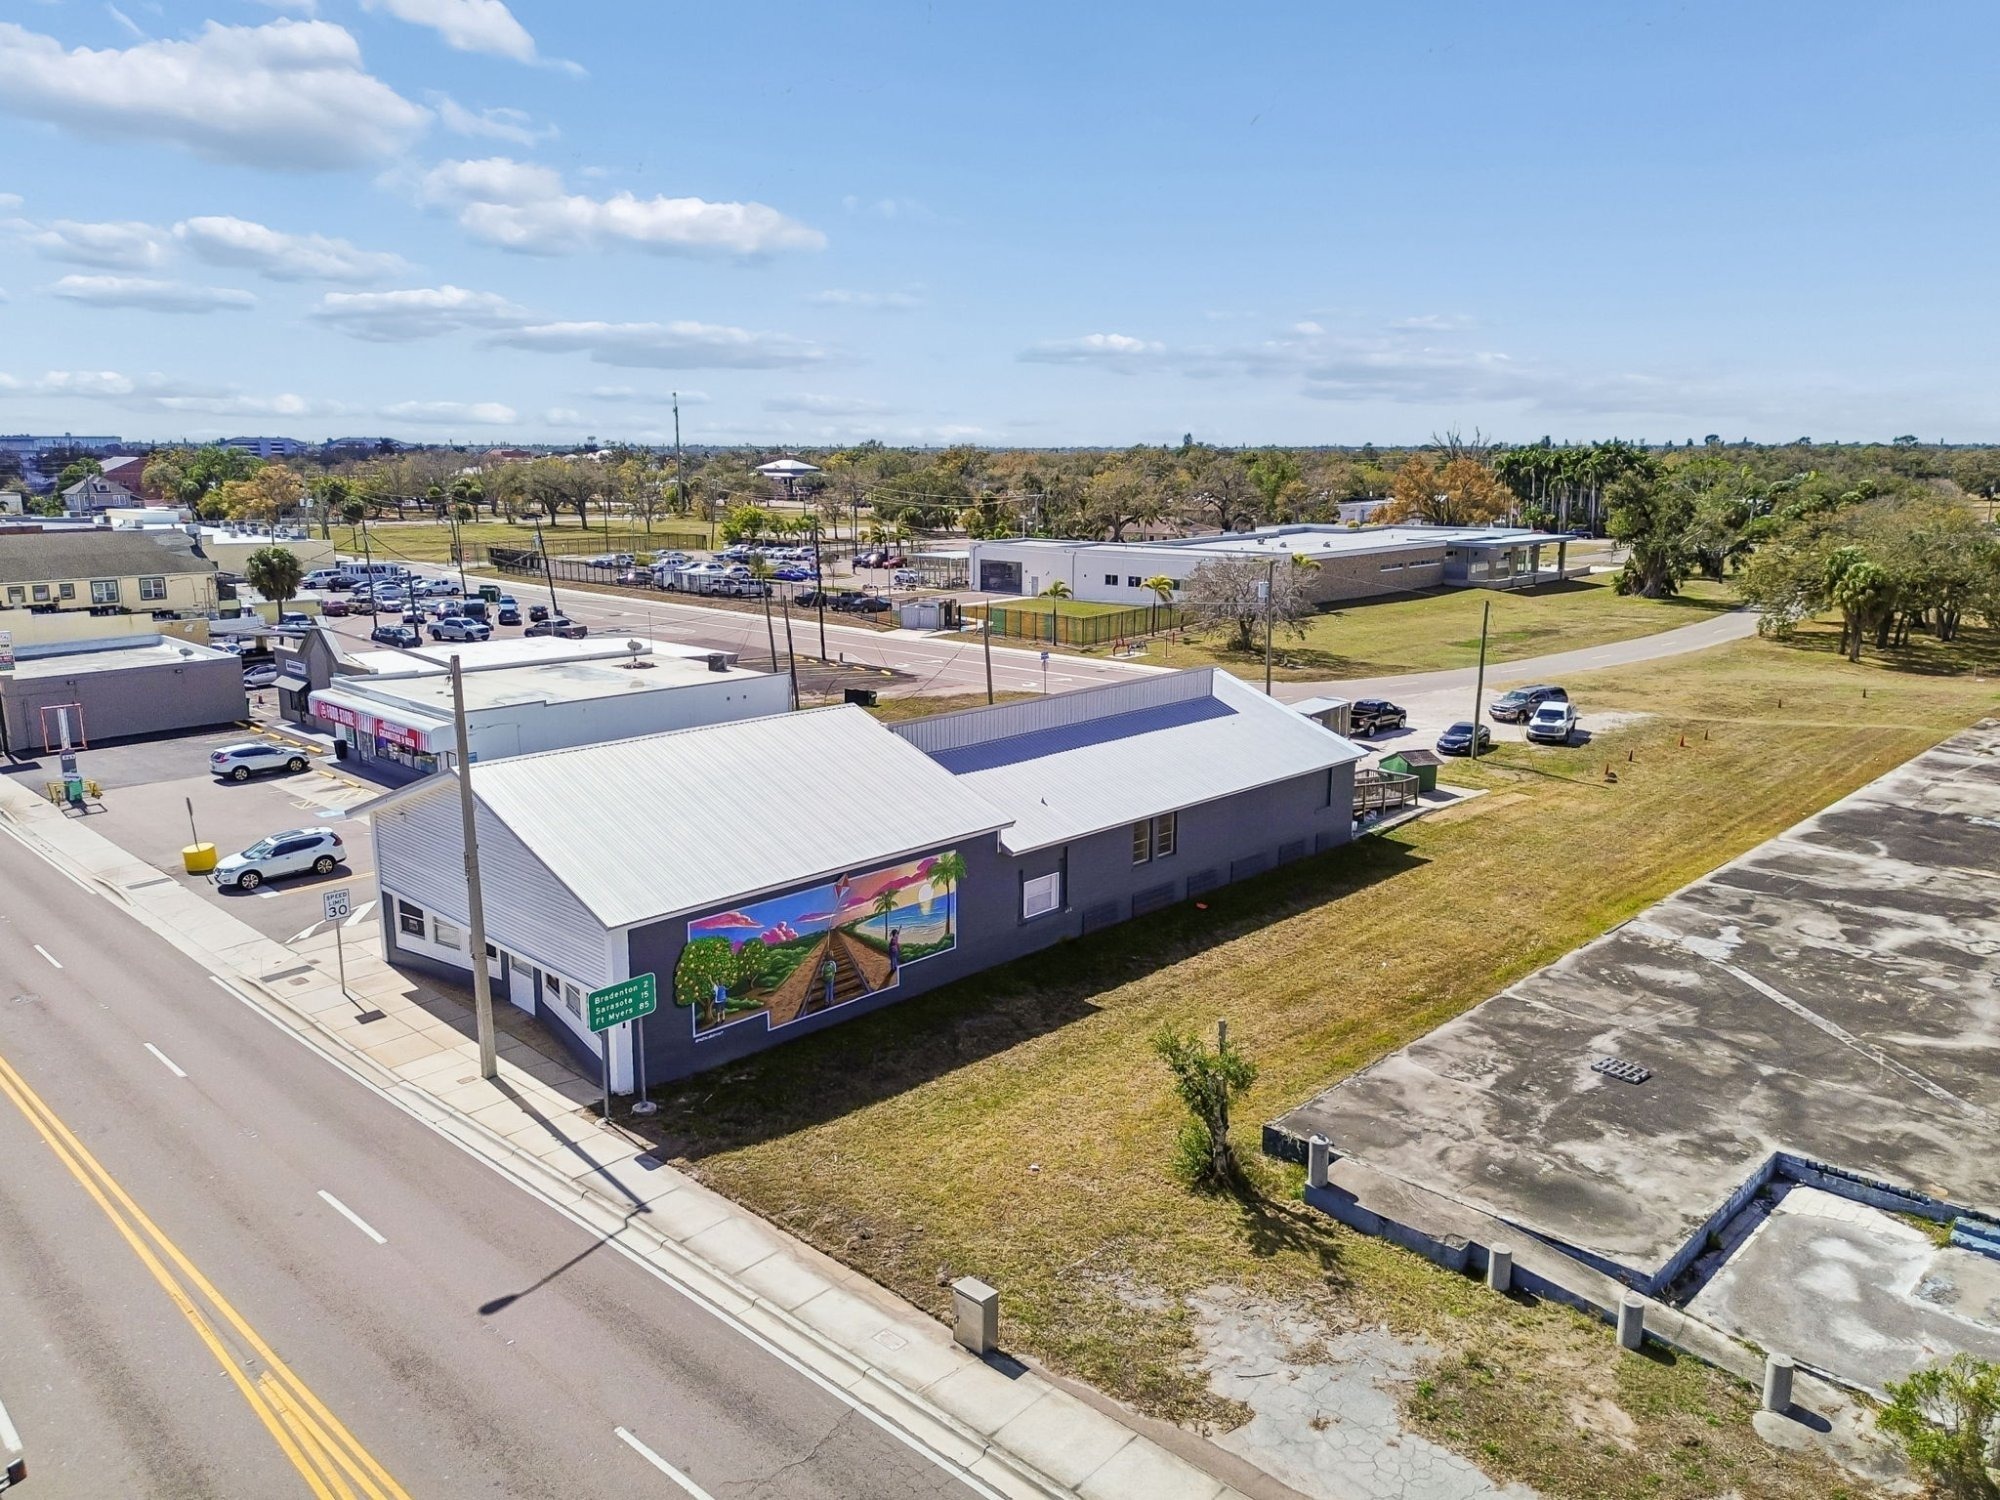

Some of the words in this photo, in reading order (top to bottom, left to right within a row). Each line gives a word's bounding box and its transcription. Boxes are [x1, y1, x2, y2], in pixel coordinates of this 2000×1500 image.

[326, 892, 347, 901] SPEED
[328, 898, 345, 907] LIMIT
[328, 905, 347, 917] 30
[594, 985, 638, 1005] Bradenton
[643, 980, 649, 988] 2
[595, 998, 633, 1015] Sarasota
[641, 990, 649, 999] 15
[595, 1016, 605, 1026] Ft
[608, 1007, 634, 1020] Myers
[639, 1001, 650, 1010] 85
